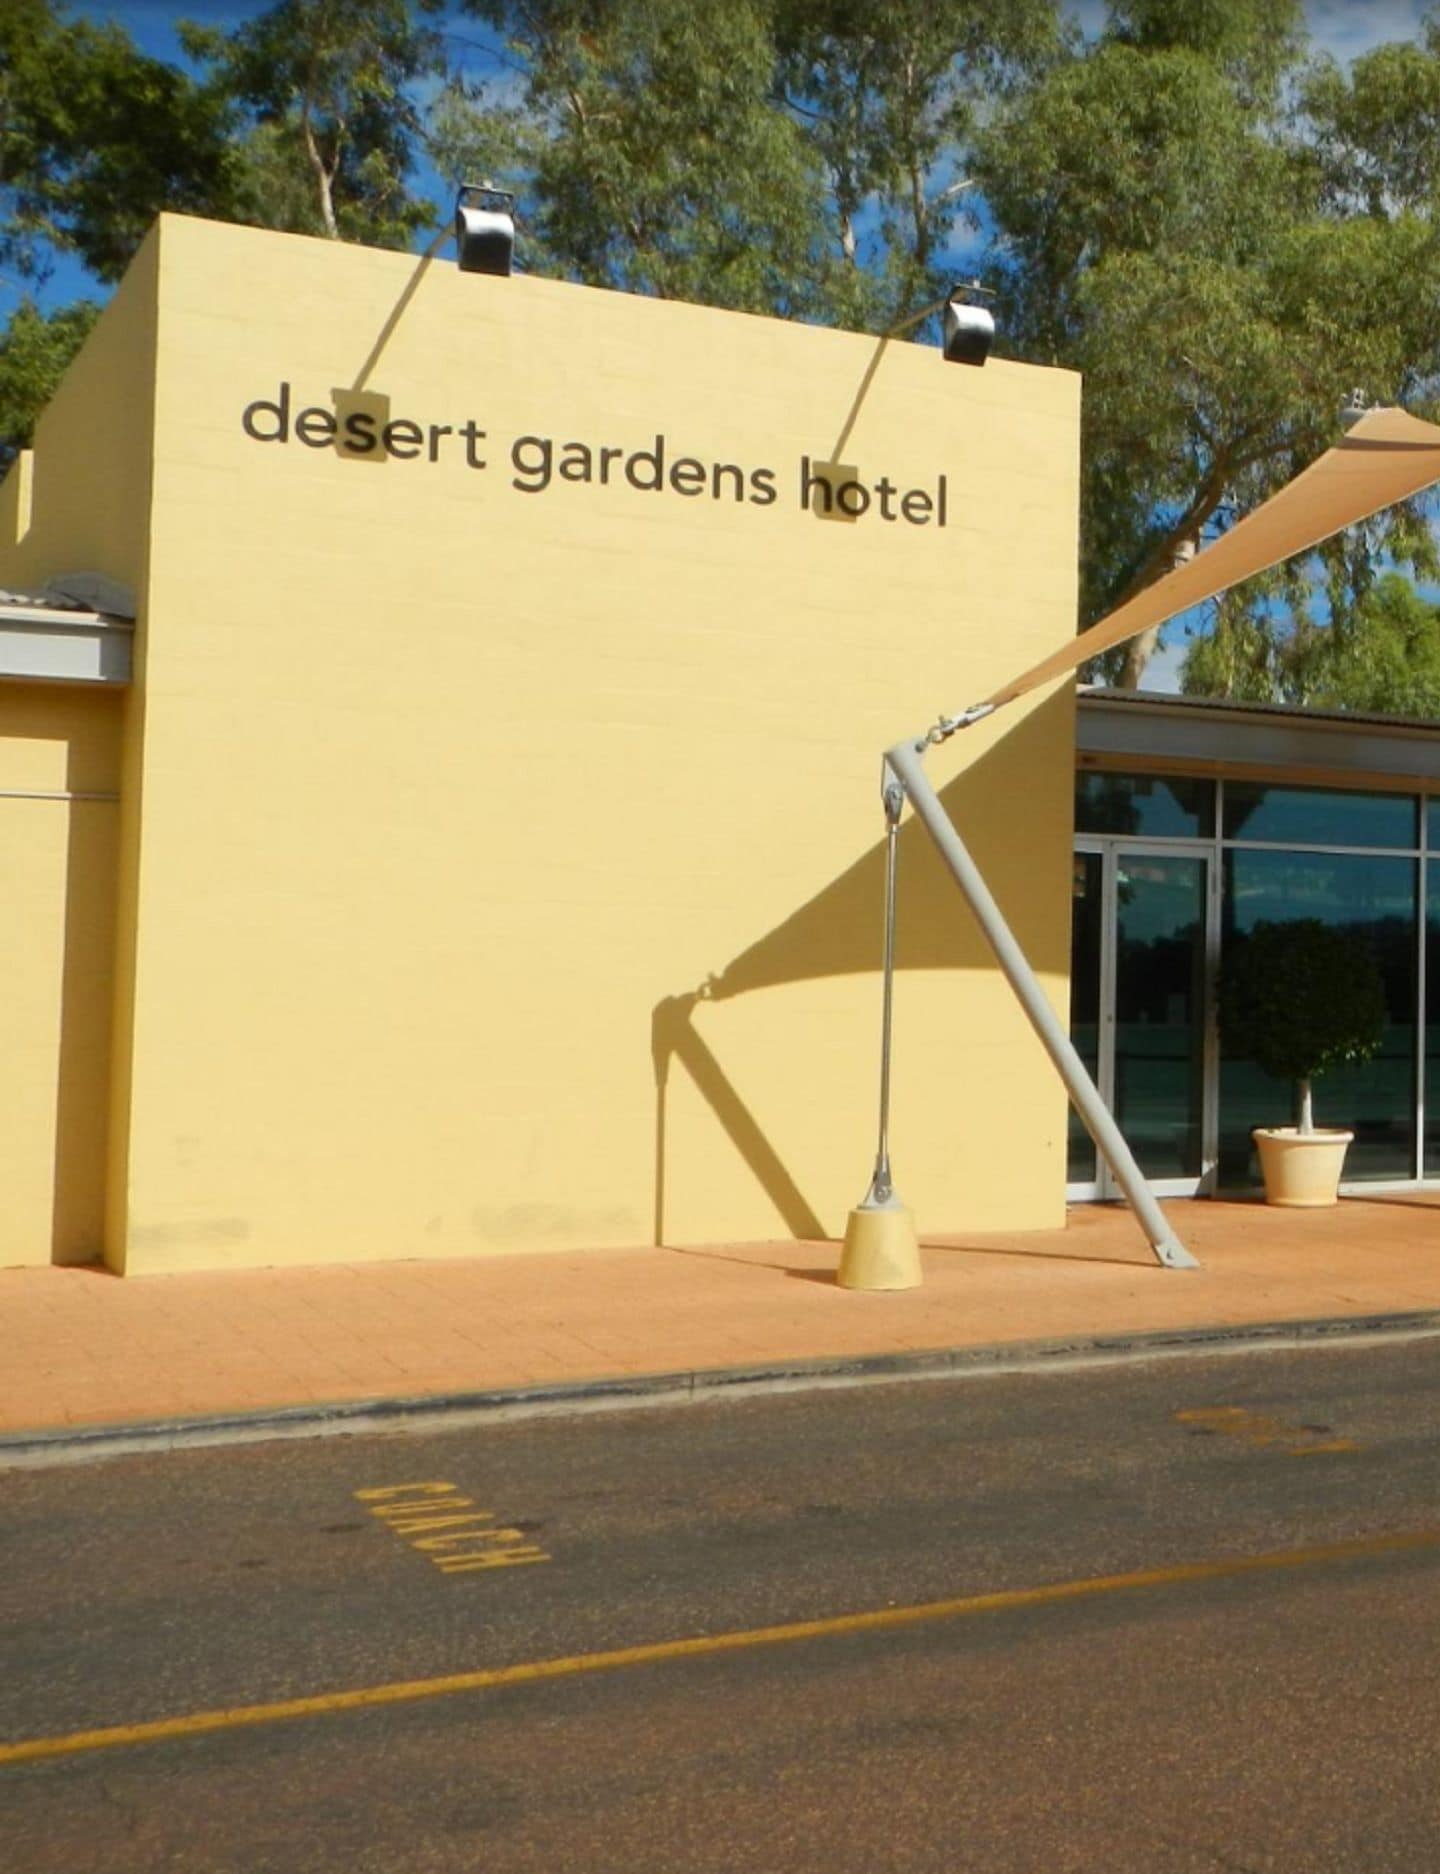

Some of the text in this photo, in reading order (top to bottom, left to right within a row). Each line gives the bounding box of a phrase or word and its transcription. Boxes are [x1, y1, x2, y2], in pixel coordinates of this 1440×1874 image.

[242, 381, 947, 528] desert gardens hotel
[353, 1481, 552, 1574] COACH
